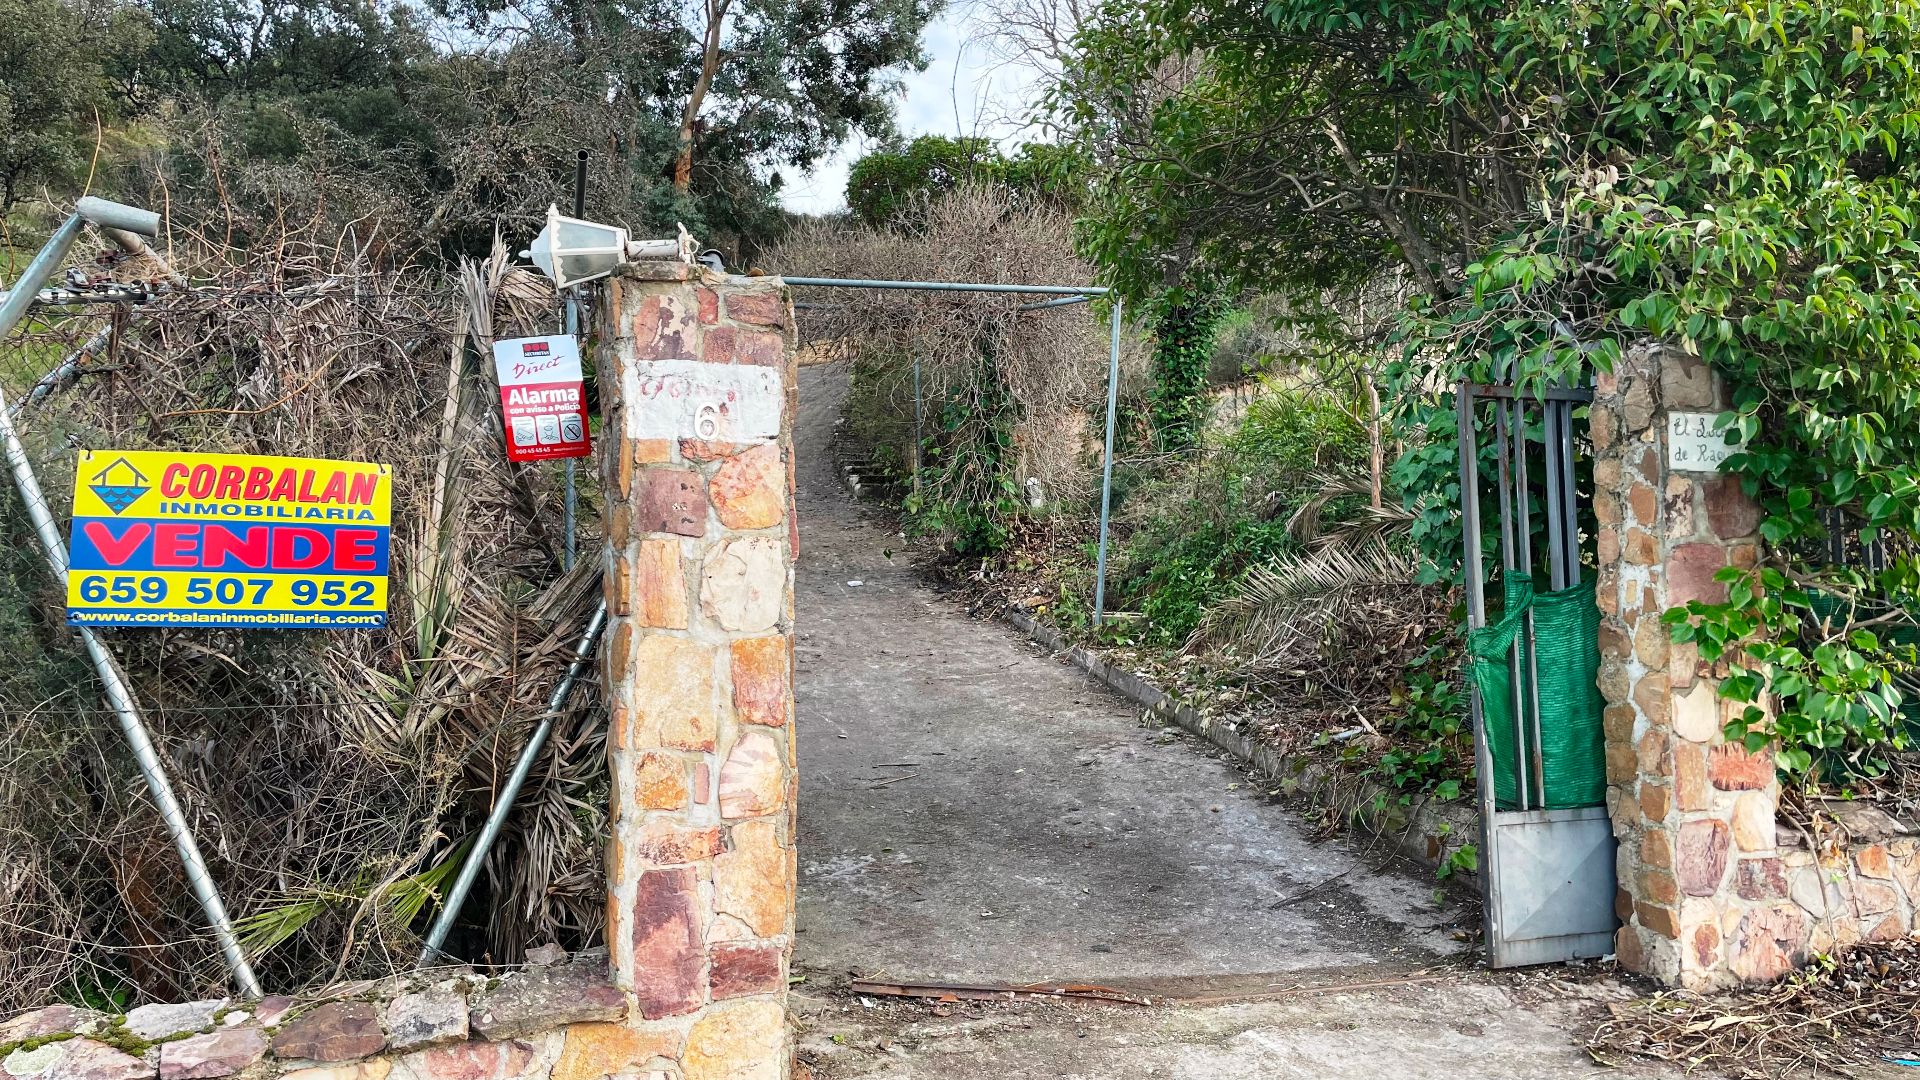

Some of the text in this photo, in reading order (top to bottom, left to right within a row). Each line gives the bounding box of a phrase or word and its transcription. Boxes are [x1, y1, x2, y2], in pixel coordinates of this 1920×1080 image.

[512, 355, 565, 378] Direct
[508, 388, 580, 405] Alarma
[526, 405, 547, 413] aviso
[694, 402, 720, 441] 6
[1674, 446, 1688, 461] de
[160, 462, 377, 505] CORBALAN
[160, 502, 375, 521] INMOBILIARIA
[84, 521, 378, 571] VENDE
[80, 576, 375, 606] 659 507 952
[79, 611, 376, 625] www.corbalaninmobiliaria.com
